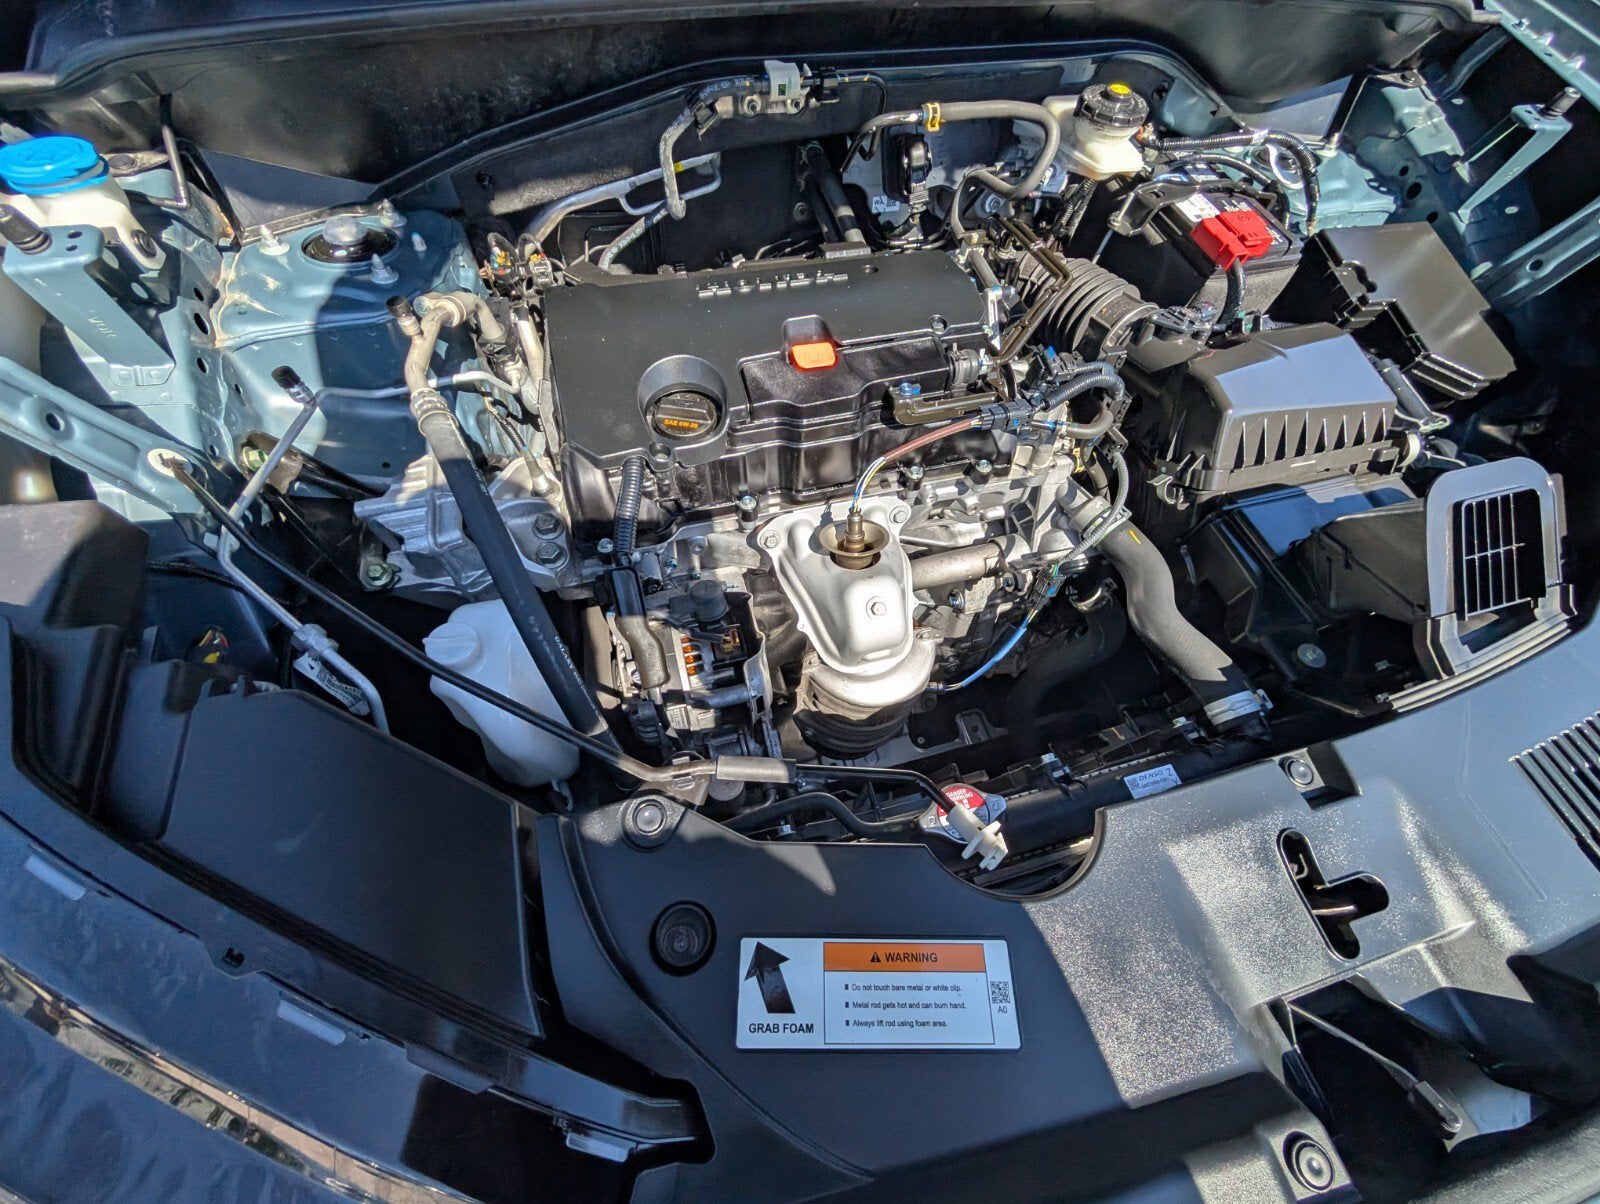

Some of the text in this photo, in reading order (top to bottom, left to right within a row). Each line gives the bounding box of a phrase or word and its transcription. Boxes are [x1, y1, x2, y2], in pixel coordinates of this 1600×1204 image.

[663, 419, 678, 427] SAE
[554, 636, 575, 669] GALAXY
[1139, 770, 1163, 781] DENSO
[885, 952, 938, 963] WARNING
[950, 984, 963, 993] clip.
[853, 1001, 870, 1009] Metal
[871, 1001, 882, 1009] rod
[883, 1002, 896, 1011] gets
[897, 1001, 908, 1009] hot
[748, 1023, 815, 1034] GRAB FOAM
[853, 1020, 876, 1029] Always
[897, 1020, 914, 1029] using
